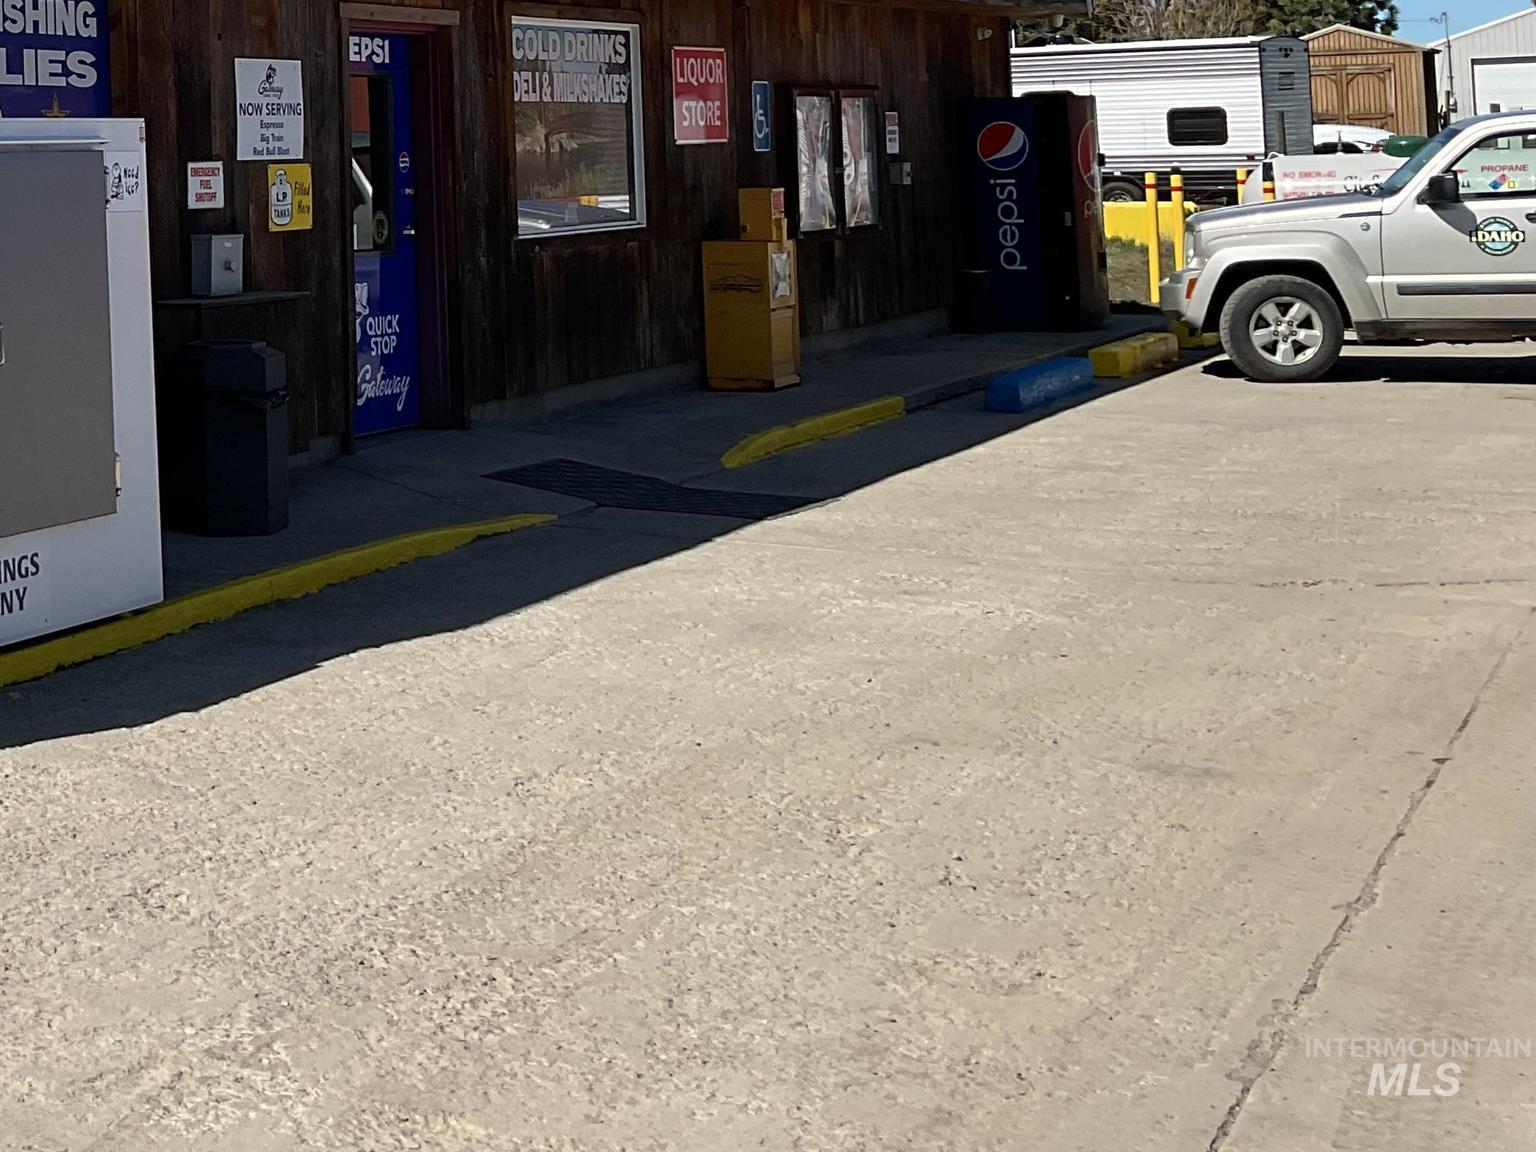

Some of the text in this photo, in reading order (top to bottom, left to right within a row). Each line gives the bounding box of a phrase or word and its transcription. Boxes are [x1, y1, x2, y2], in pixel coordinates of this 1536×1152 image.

[349, 36, 390, 64] EPSI
[512, 28, 627, 64] COLD DRINKS
[676, 57, 724, 87] LIQUOR
[513, 71, 628, 104] DELI & MILKSHAKES
[239, 102, 302, 117] NOW SERVING
[682, 100, 721, 127] STORE
[1481, 164, 1529, 173] PROPANE
[990, 179, 1027, 270] pepsi
[366, 314, 400, 336] QUICK
[371, 335, 397, 356] STOP
[357, 364, 410, 412] Gateway
